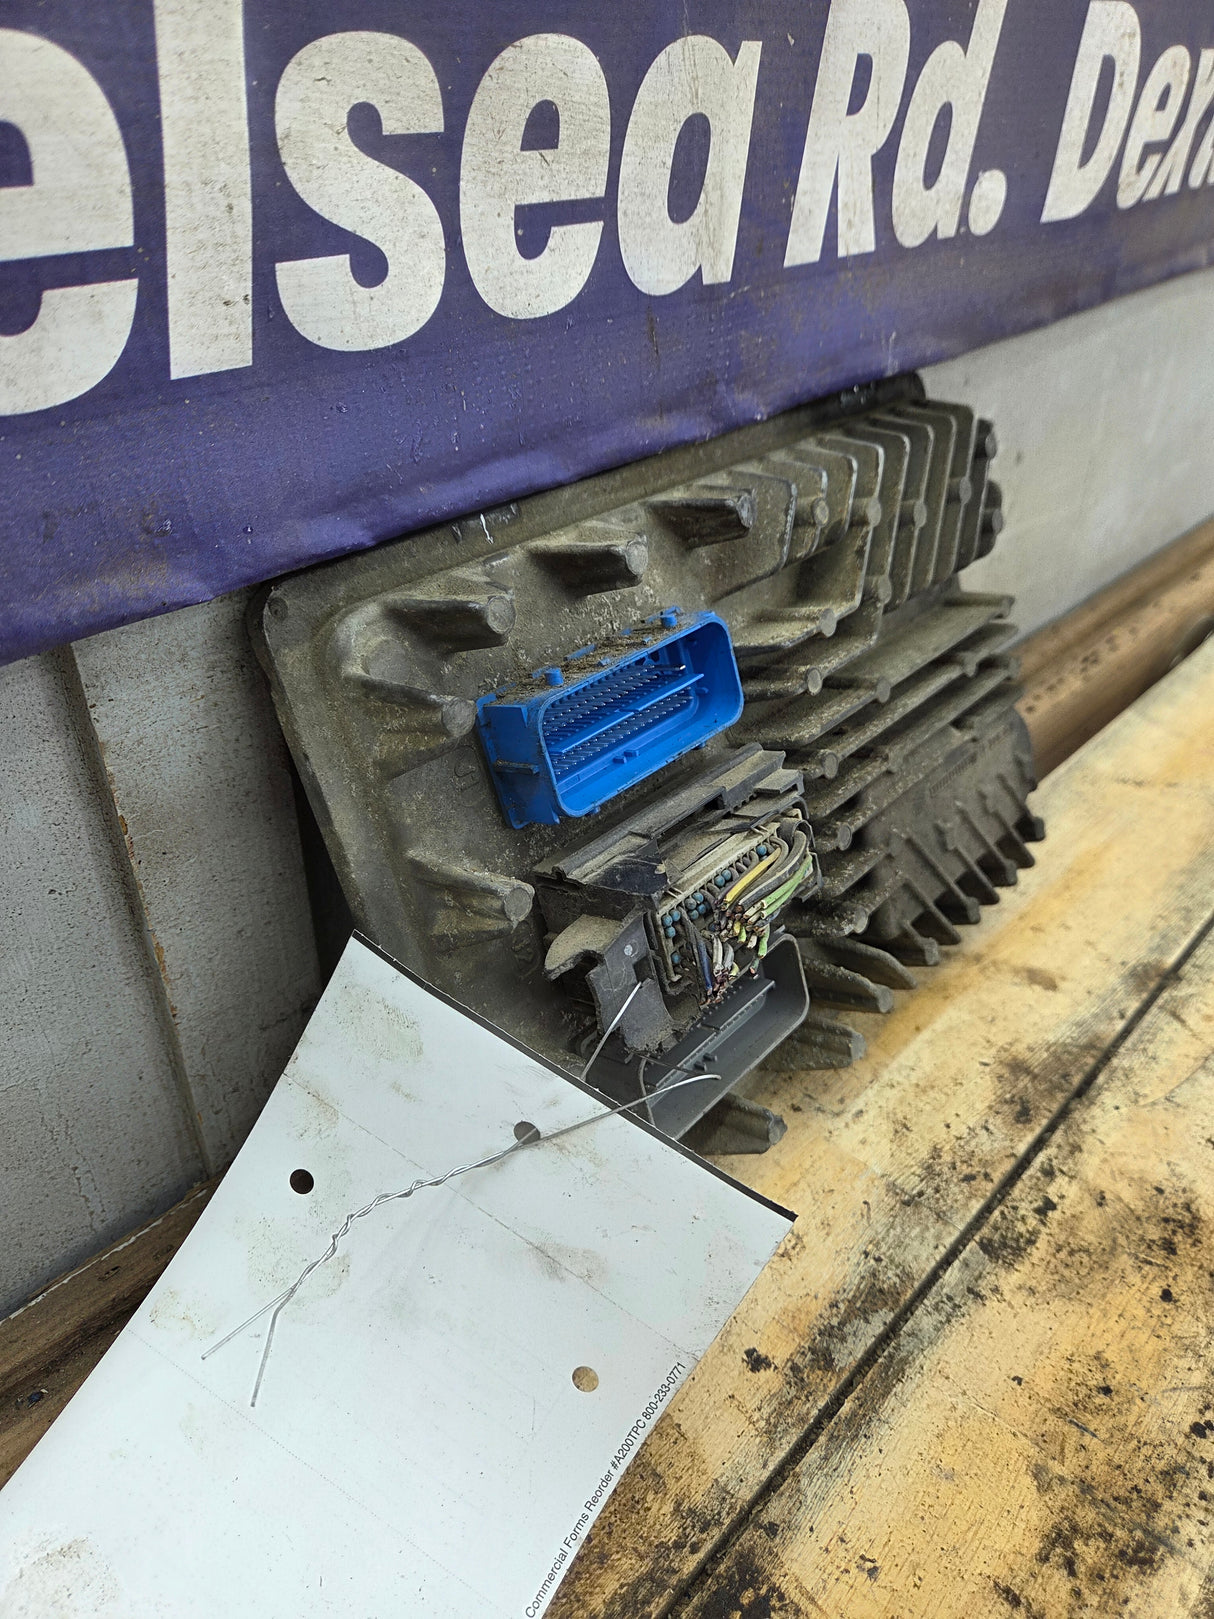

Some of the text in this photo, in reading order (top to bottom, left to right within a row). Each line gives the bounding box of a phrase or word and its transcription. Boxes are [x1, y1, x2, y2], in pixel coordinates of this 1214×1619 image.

[784, 0, 1007, 268] Rd.
[1040, 0, 1214, 224] Dex
[525, 1361, 687, 1619] Commercial Forms Reorder #A200TPC 800-233-0771
